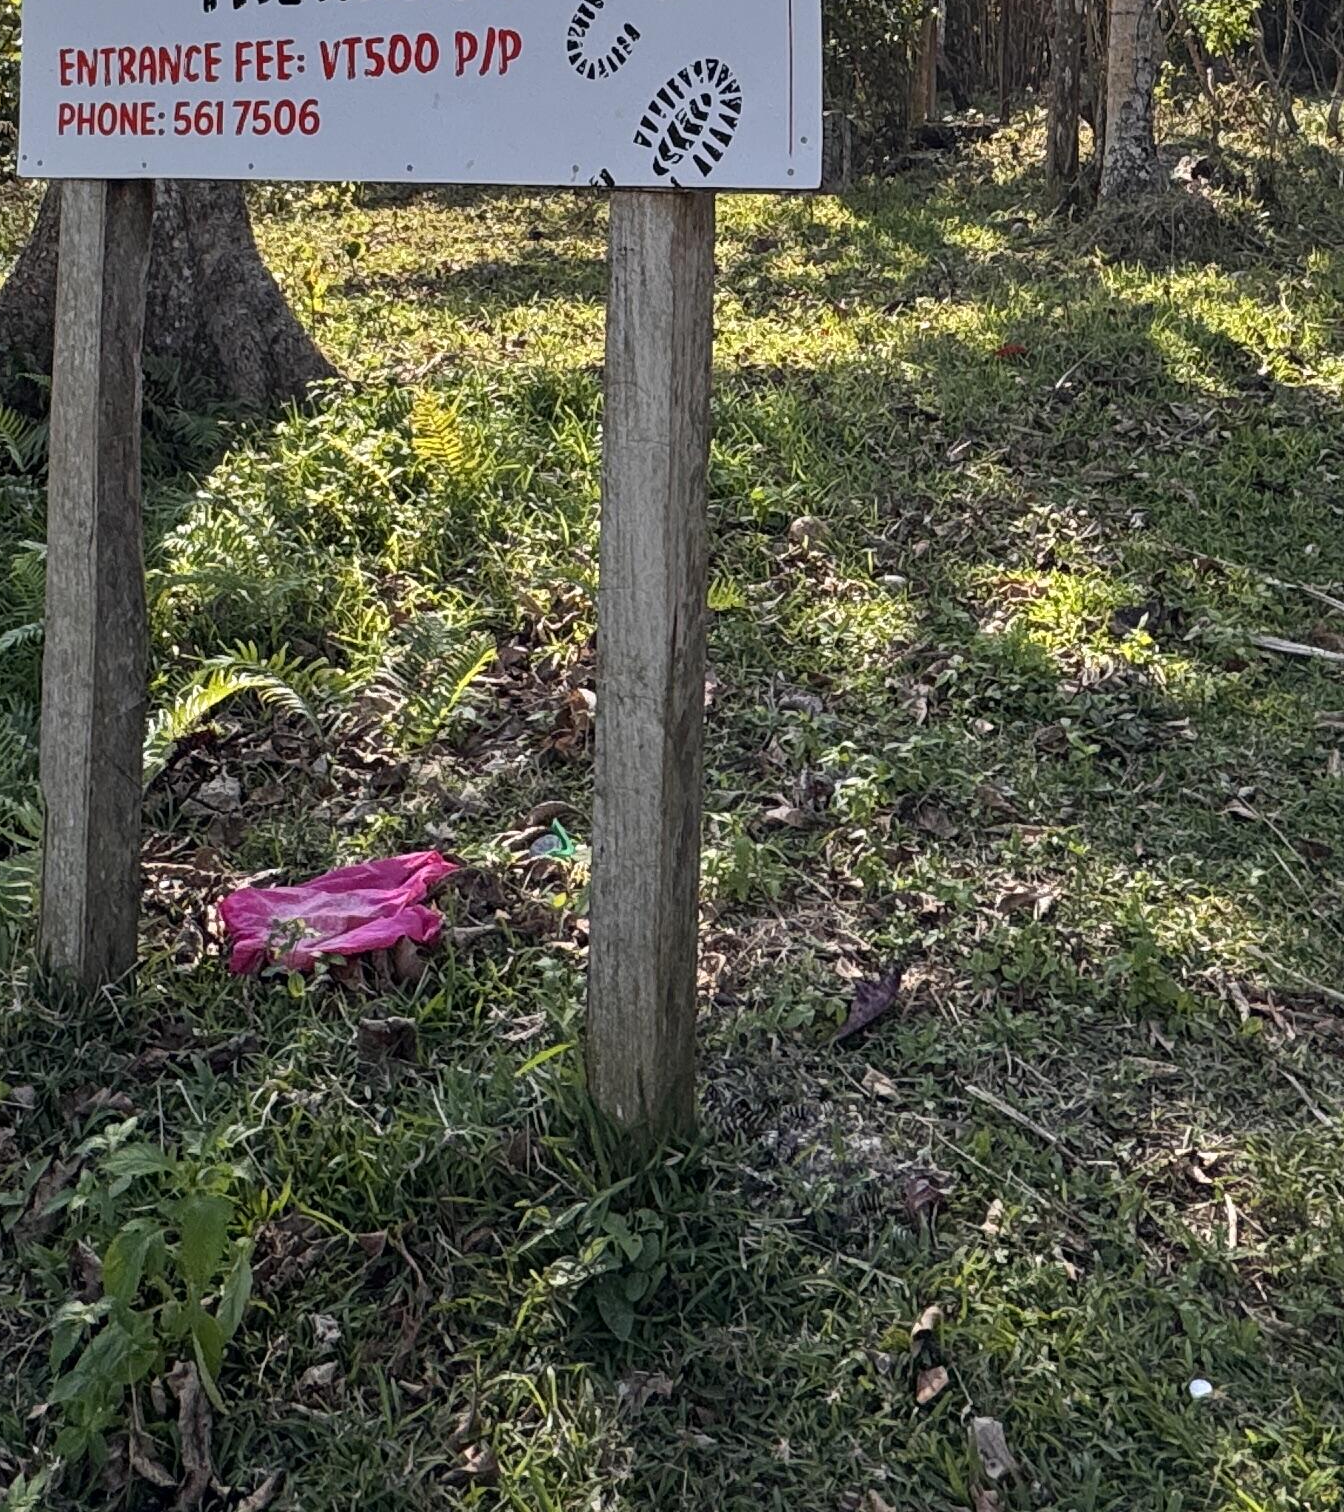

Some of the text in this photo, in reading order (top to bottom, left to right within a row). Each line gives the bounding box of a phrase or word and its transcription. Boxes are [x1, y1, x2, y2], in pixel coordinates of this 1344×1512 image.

[59, 27, 522, 87] ENTRANCE FEE: VT500 P/P
[58, 102, 166, 136] PHONE:
